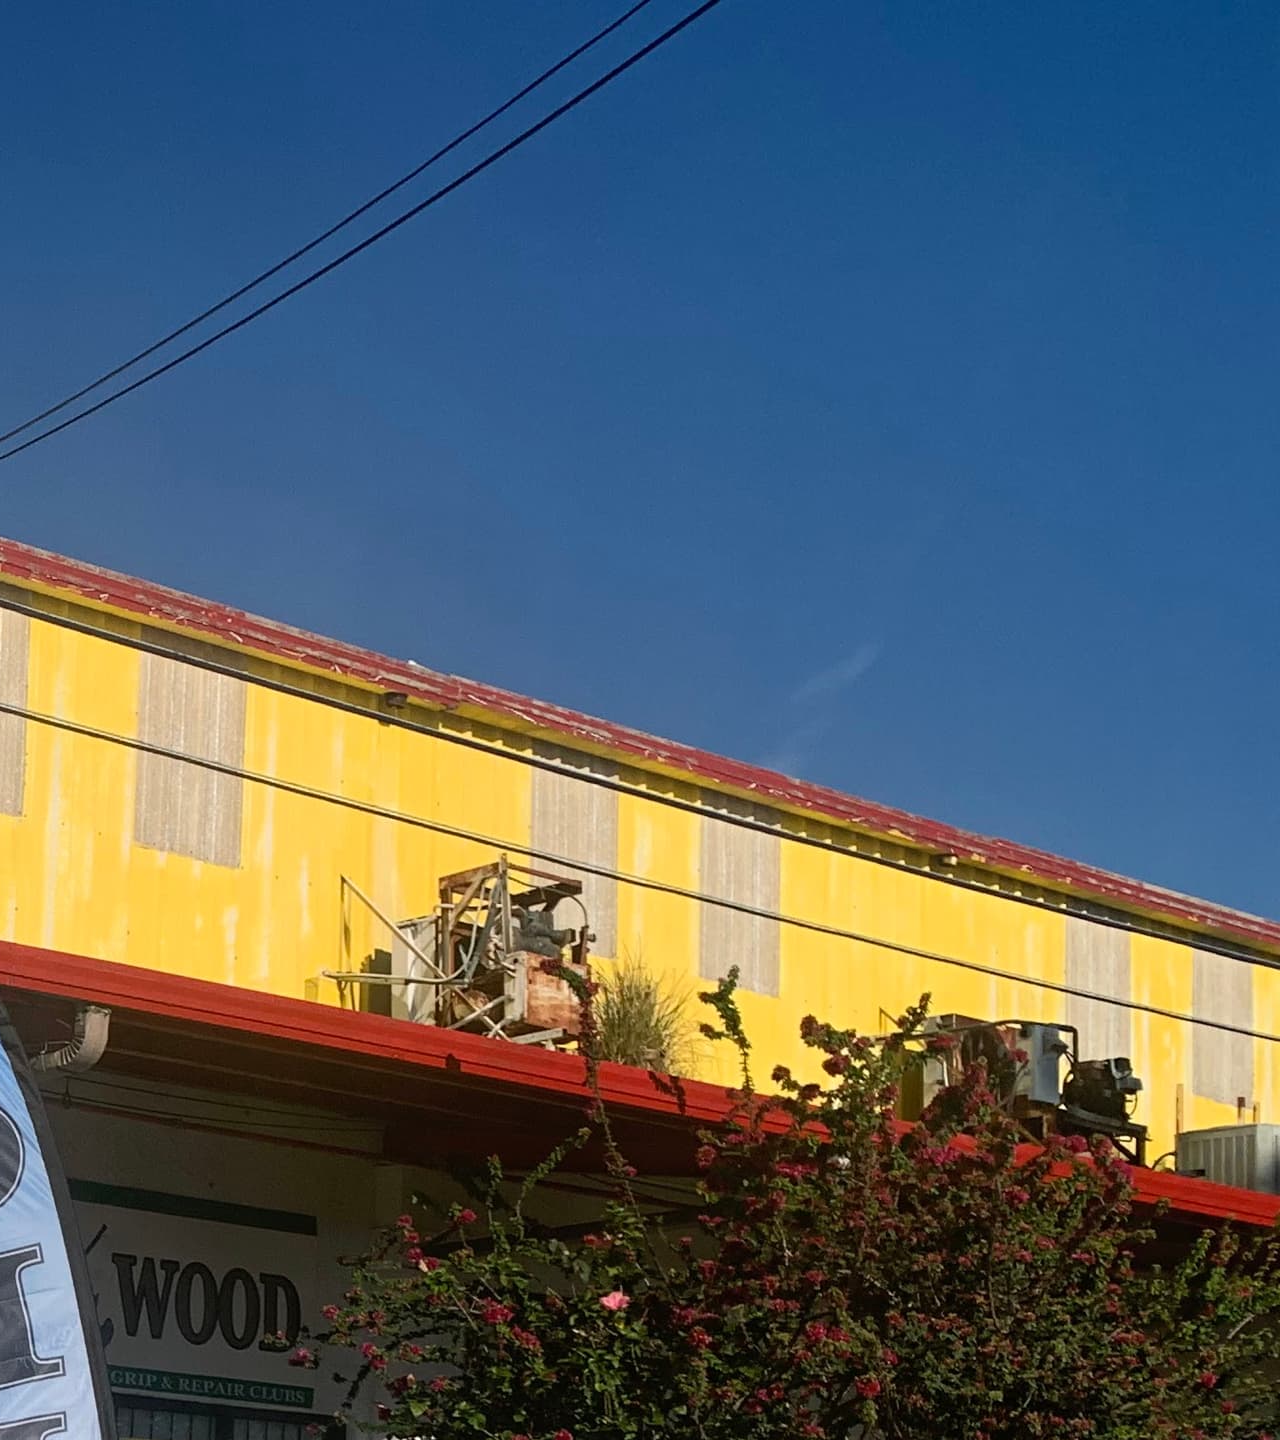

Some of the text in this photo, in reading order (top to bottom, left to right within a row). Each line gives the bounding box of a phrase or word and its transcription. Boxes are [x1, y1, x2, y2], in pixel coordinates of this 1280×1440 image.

[111, 1252, 301, 1353] WOOD
[110, 1370, 305, 1403] GRIP & REPAIR CLUBS
